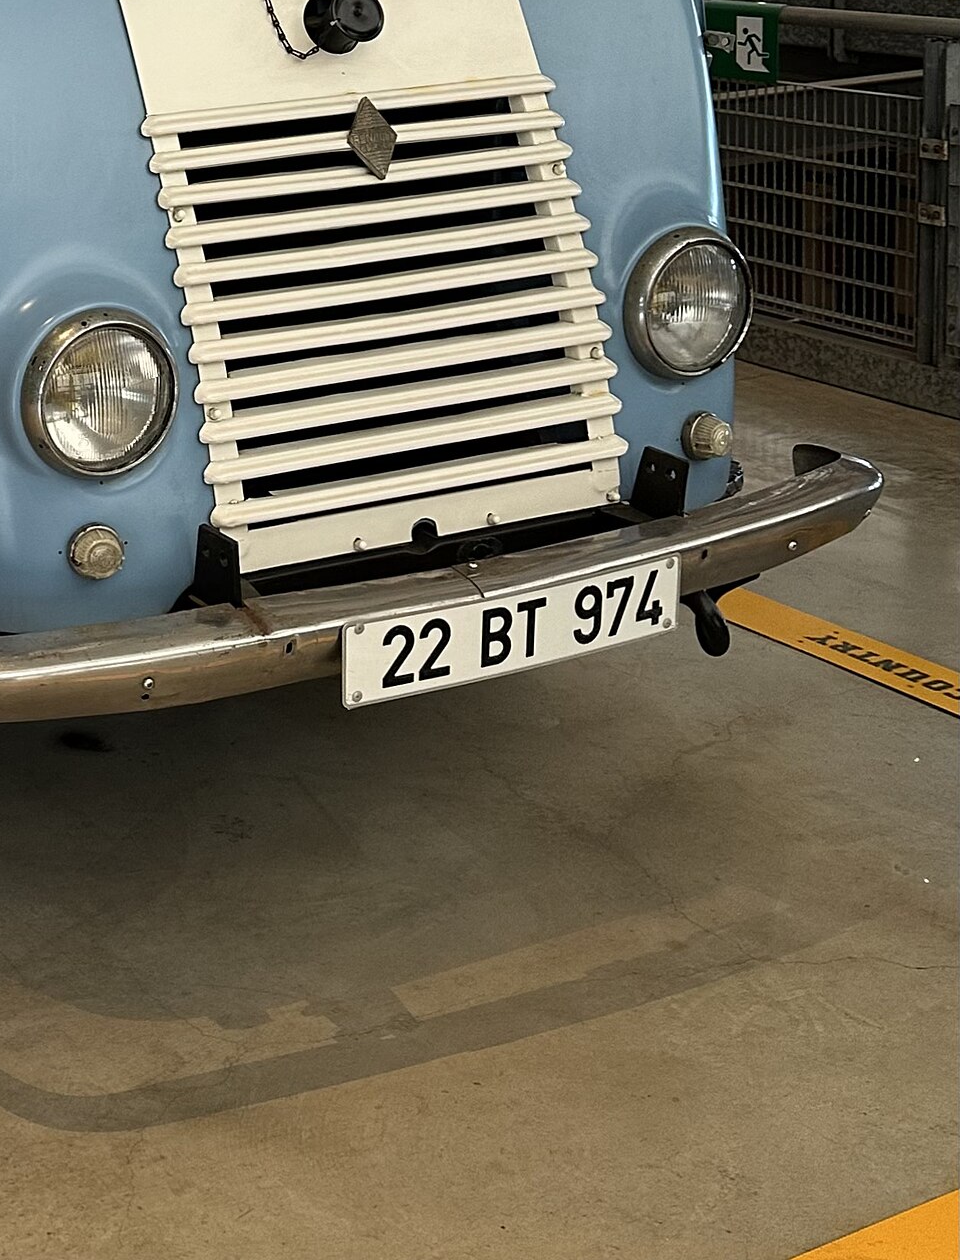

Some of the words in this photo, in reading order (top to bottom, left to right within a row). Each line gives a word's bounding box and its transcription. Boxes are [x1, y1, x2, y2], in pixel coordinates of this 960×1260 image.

[381, 617, 451, 689] 22
[480, 596, 547, 669] BT
[573, 569, 663, 645] 974
